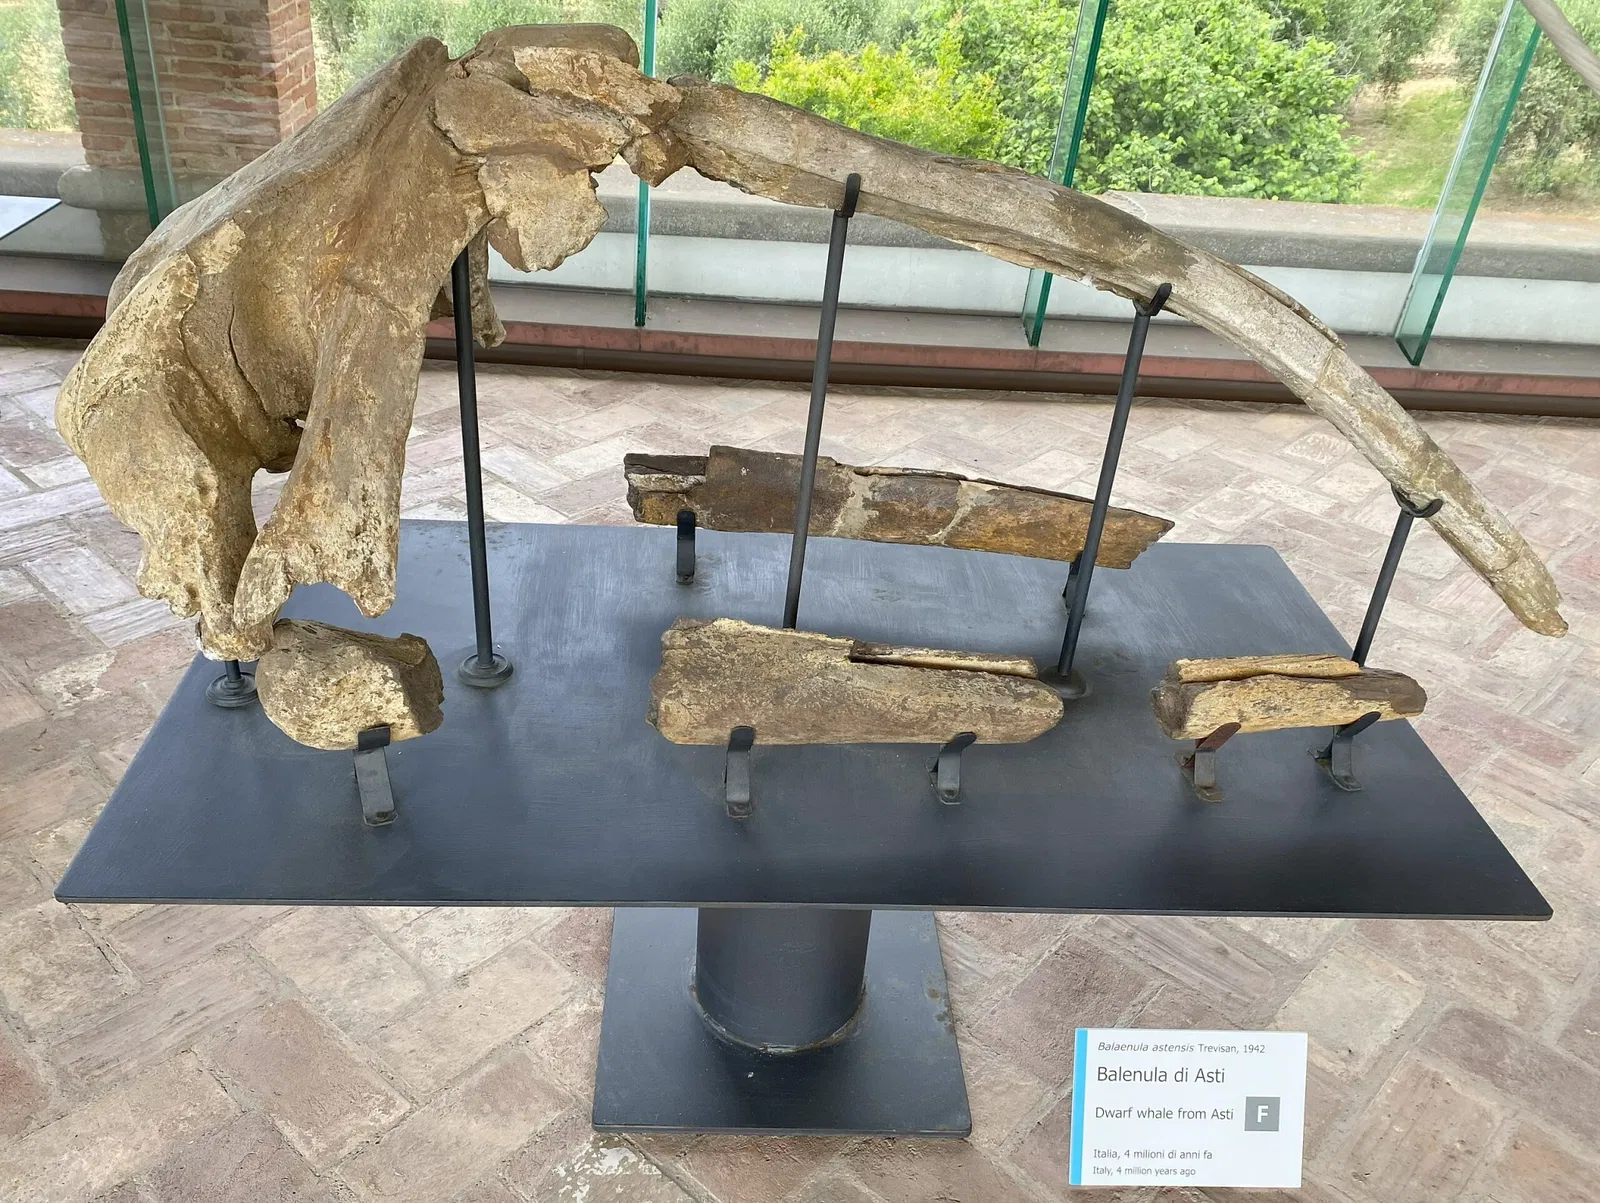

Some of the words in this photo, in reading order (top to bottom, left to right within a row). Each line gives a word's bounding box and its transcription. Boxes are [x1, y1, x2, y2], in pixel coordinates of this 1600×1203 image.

[1098, 1042, 1149, 1052] Balaenula
[1152, 1043, 1194, 1052] astensis
[1198, 1044, 1239, 1054] Trevisan,
[1243, 1045, 1265, 1053] 1942
[1097, 1066, 1167, 1082] Balenula
[1174, 1067, 1188, 1082] di
[1194, 1068, 1225, 1083] Asti
[1096, 1107, 1133, 1119] Dwarf
[1137, 1108, 1173, 1119] whale
[1178, 1108, 1206, 1119] from
[1211, 1109, 1234, 1120] Asti
[1257, 1105, 1269, 1123] F
[1094, 1149, 1121, 1159] Italia,
[1124, 1150, 1130, 1158] 4
[1133, 1150, 1165, 1158] milioni
[1168, 1150, 1177, 1159] di
[1179, 1151, 1200, 1159] anni
[1203, 1150, 1212, 1159] fa
[1093, 1166, 1113, 1176] Italy,
[1125, 1167, 1152, 1175] million
[1155, 1167, 1177, 1176] years
[1180, 1168, 1196, 1177] ago
